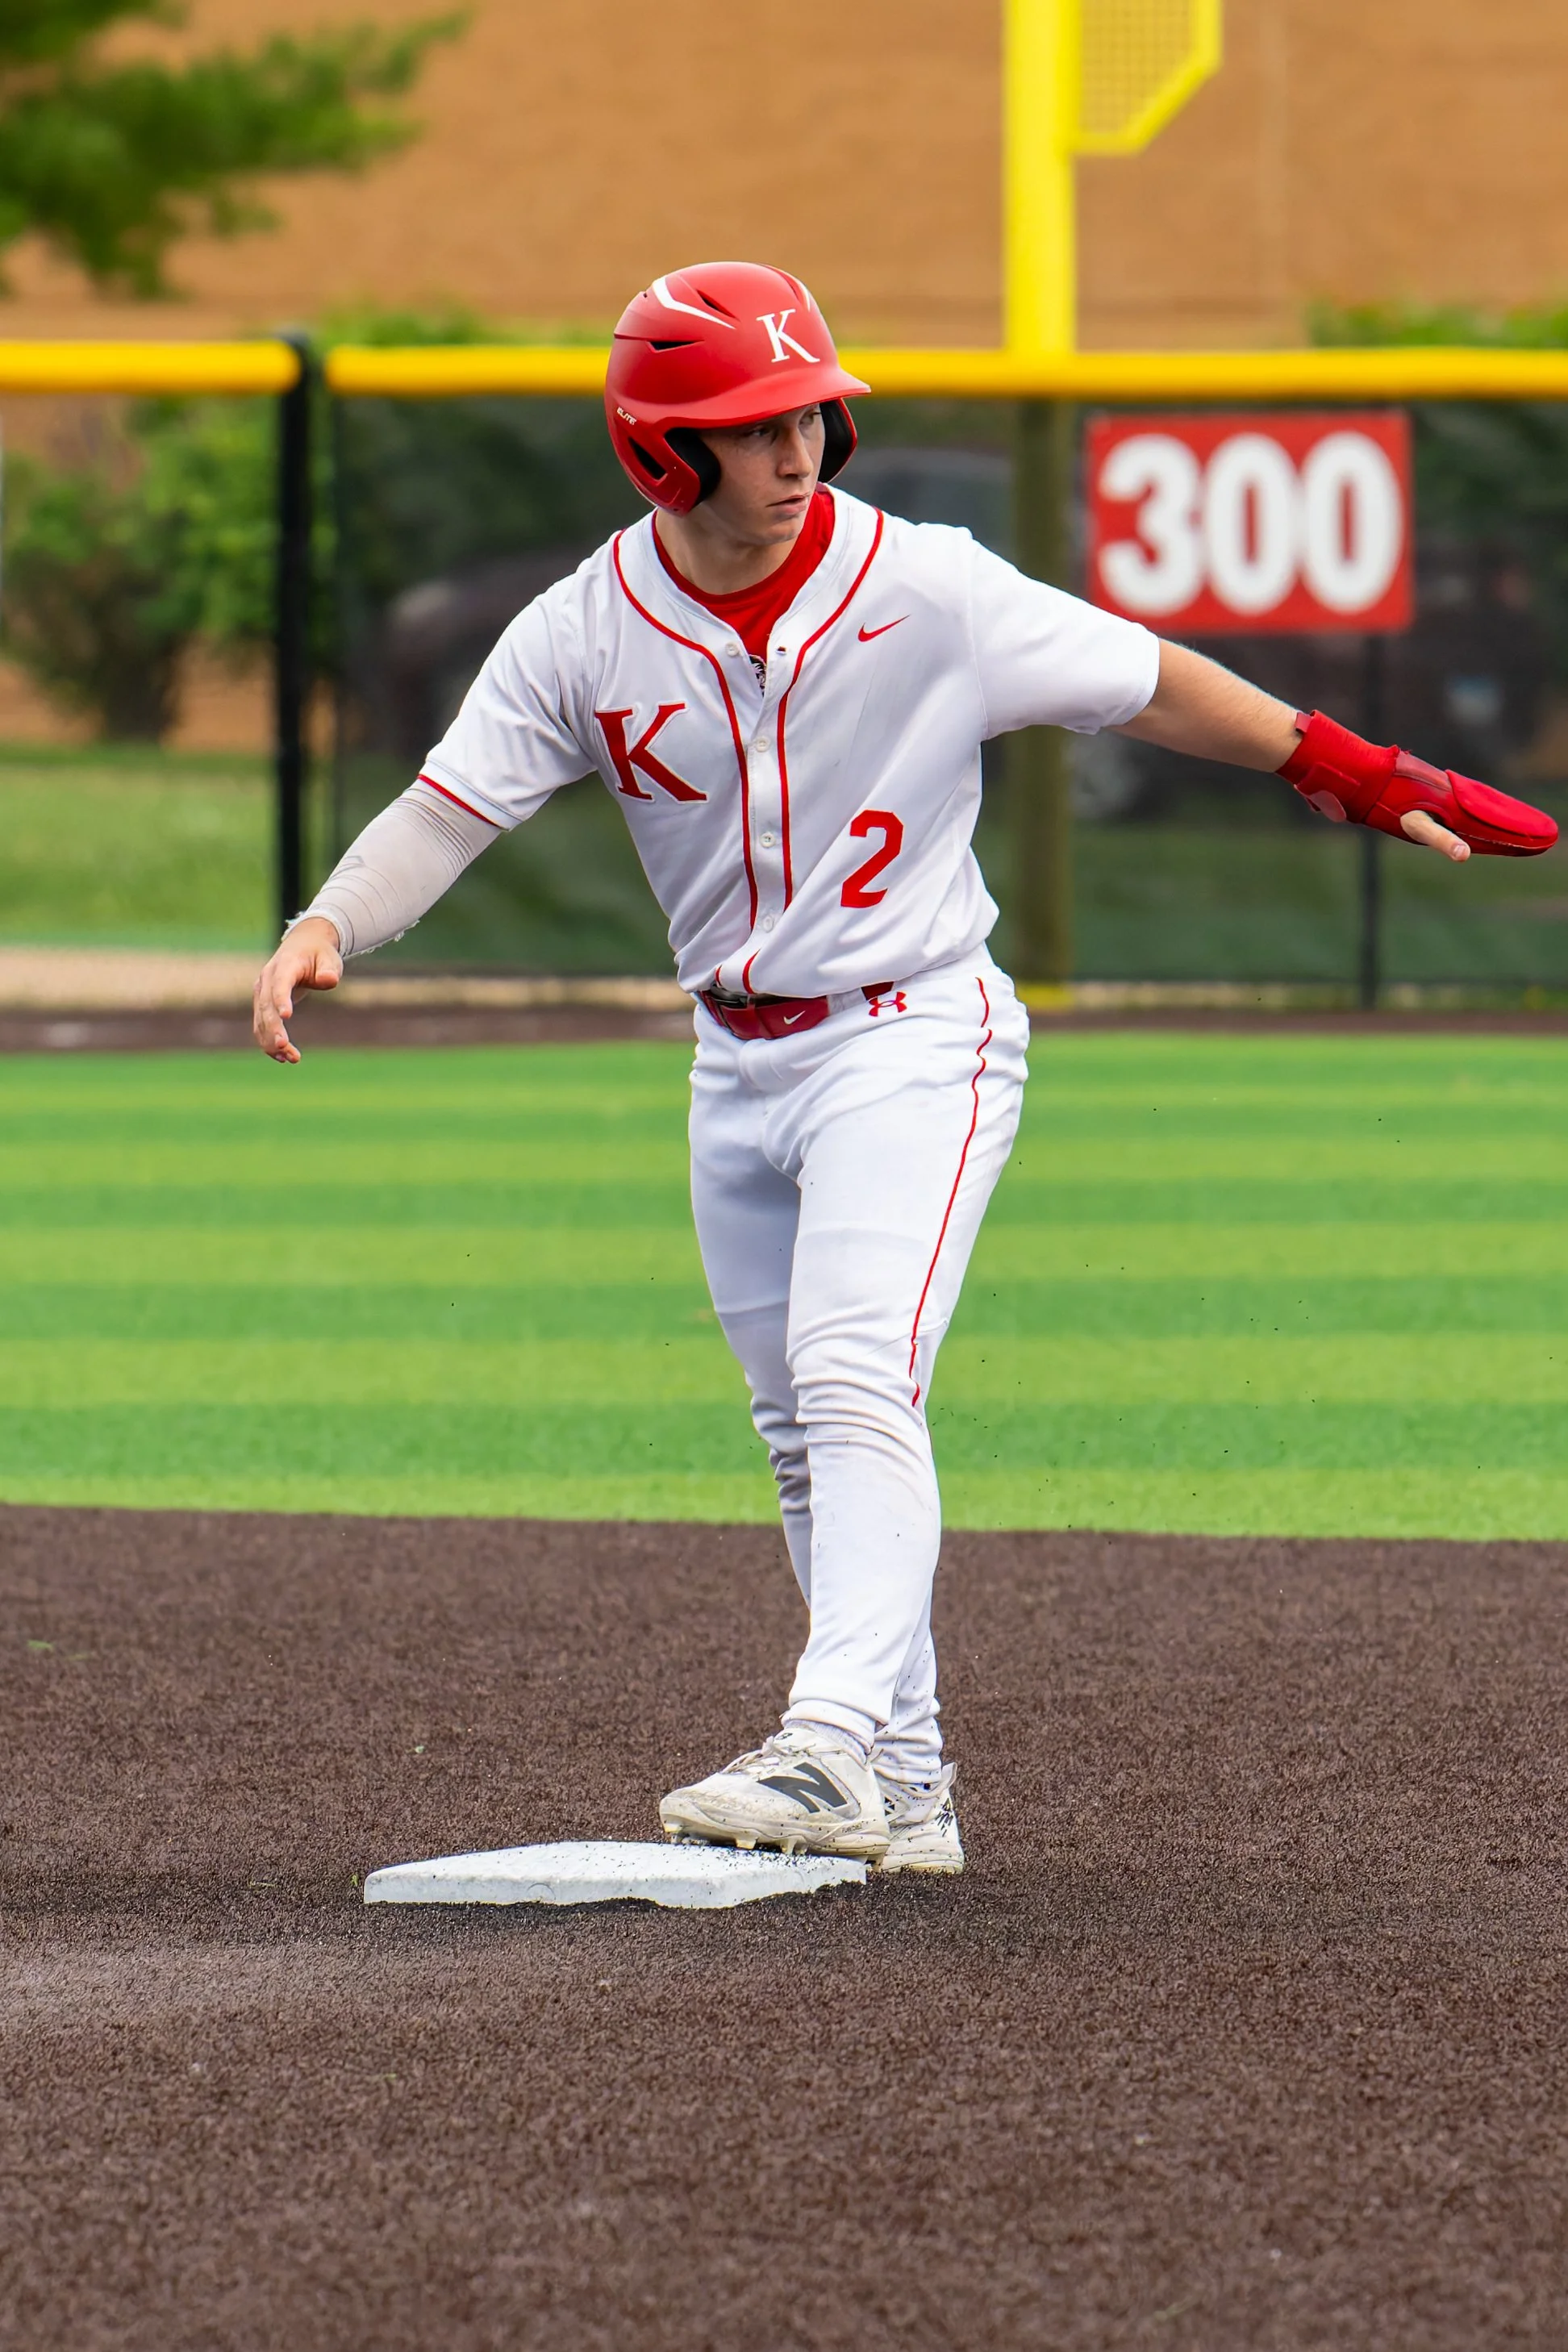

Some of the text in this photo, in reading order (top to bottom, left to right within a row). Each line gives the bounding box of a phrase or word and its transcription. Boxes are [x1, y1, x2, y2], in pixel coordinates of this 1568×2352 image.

[756, 308, 820, 363] K
[1097, 432, 1404, 617] 300
[595, 702, 707, 803] K
[841, 809, 904, 908] 2
